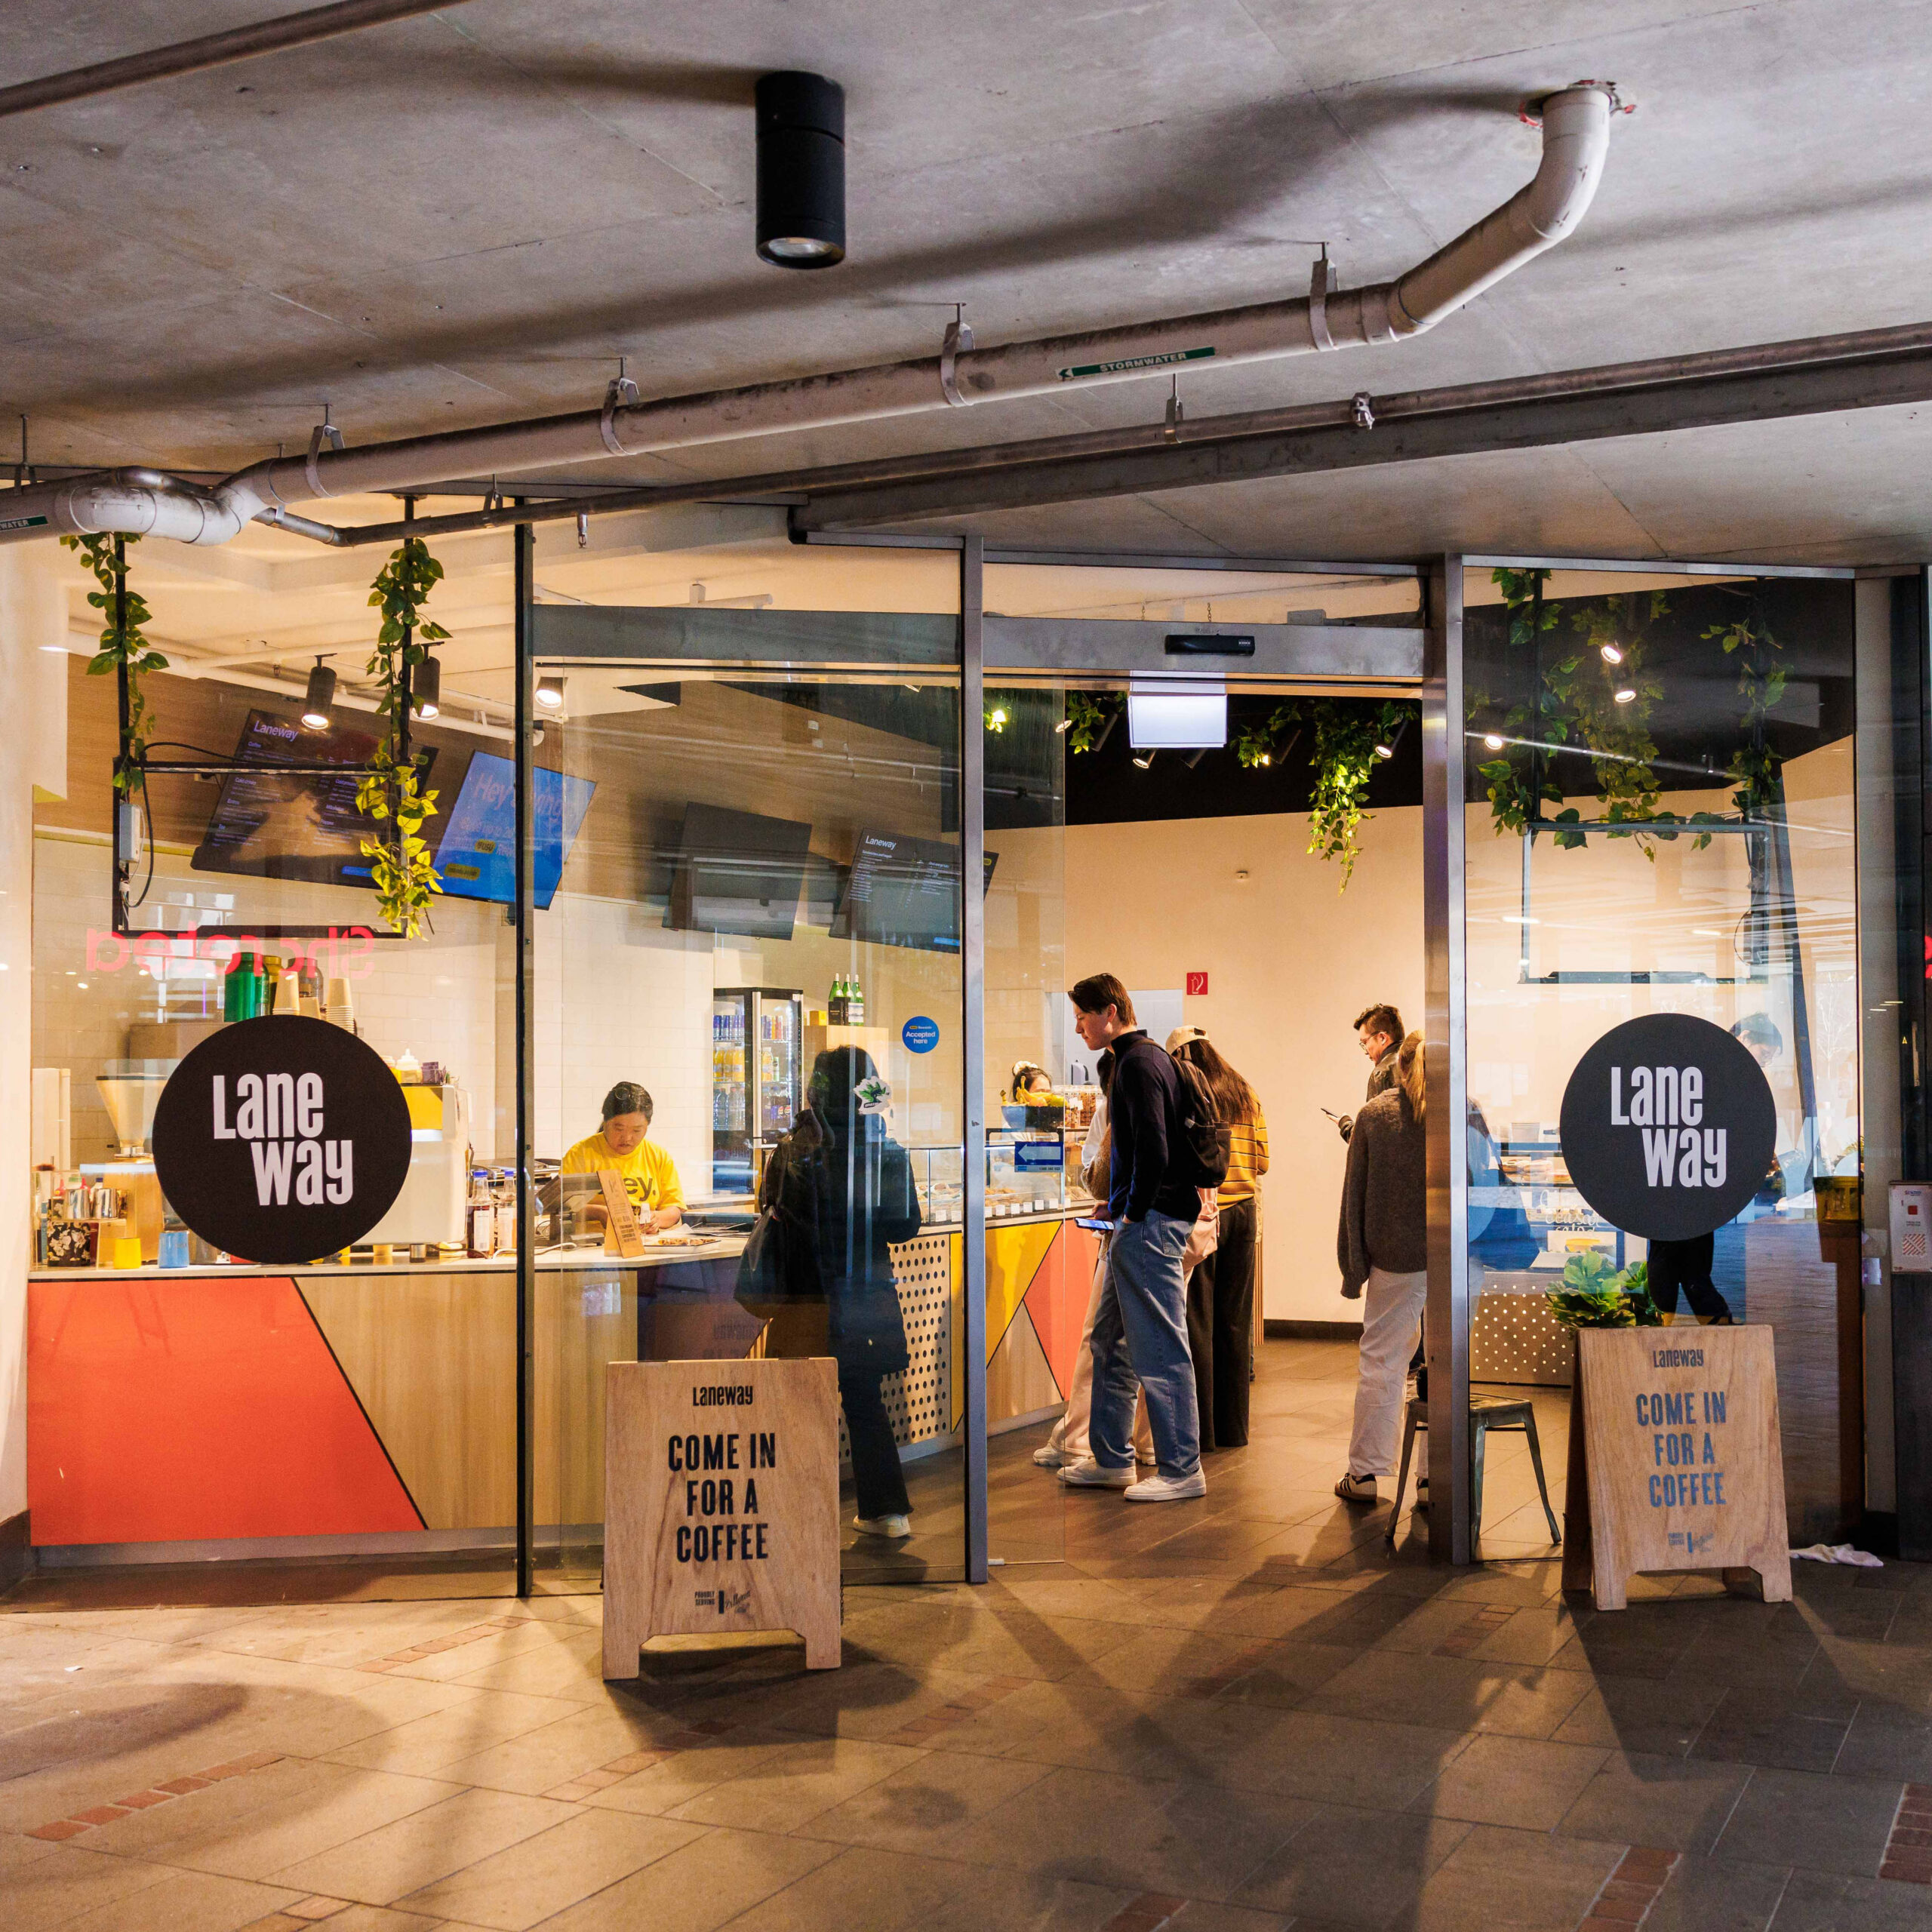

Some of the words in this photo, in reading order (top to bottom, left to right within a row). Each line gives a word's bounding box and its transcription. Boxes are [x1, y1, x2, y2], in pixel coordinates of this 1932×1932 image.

[1100, 352, 1186, 373] STORMWATER
[254, 719, 299, 742] Laneway
[865, 835, 897, 851] Laneway
[906, 1031, 936, 1039] Accepted
[213, 1072, 325, 1140] Lane
[1611, 1066, 1703, 1127] Lane
[623, 1177, 656, 1201] ey.
[1653, 1349, 1704, 1368] Laneway
[693, 1385, 754, 1407] Laneway
[1635, 1392, 1697, 1427] COME
[1703, 1391, 1727, 1425] IN
[668, 1433, 740, 1472] COME
[749, 1432, 777, 1469] IN
[1653, 1432, 1695, 1467] FOR
[1703, 1432, 1716, 1465] A
[686, 1478, 734, 1517] FOR
[743, 1478, 759, 1515] A
[1647, 1472, 1727, 1509] COFFEE
[676, 1523, 769, 1563] COFFEE
